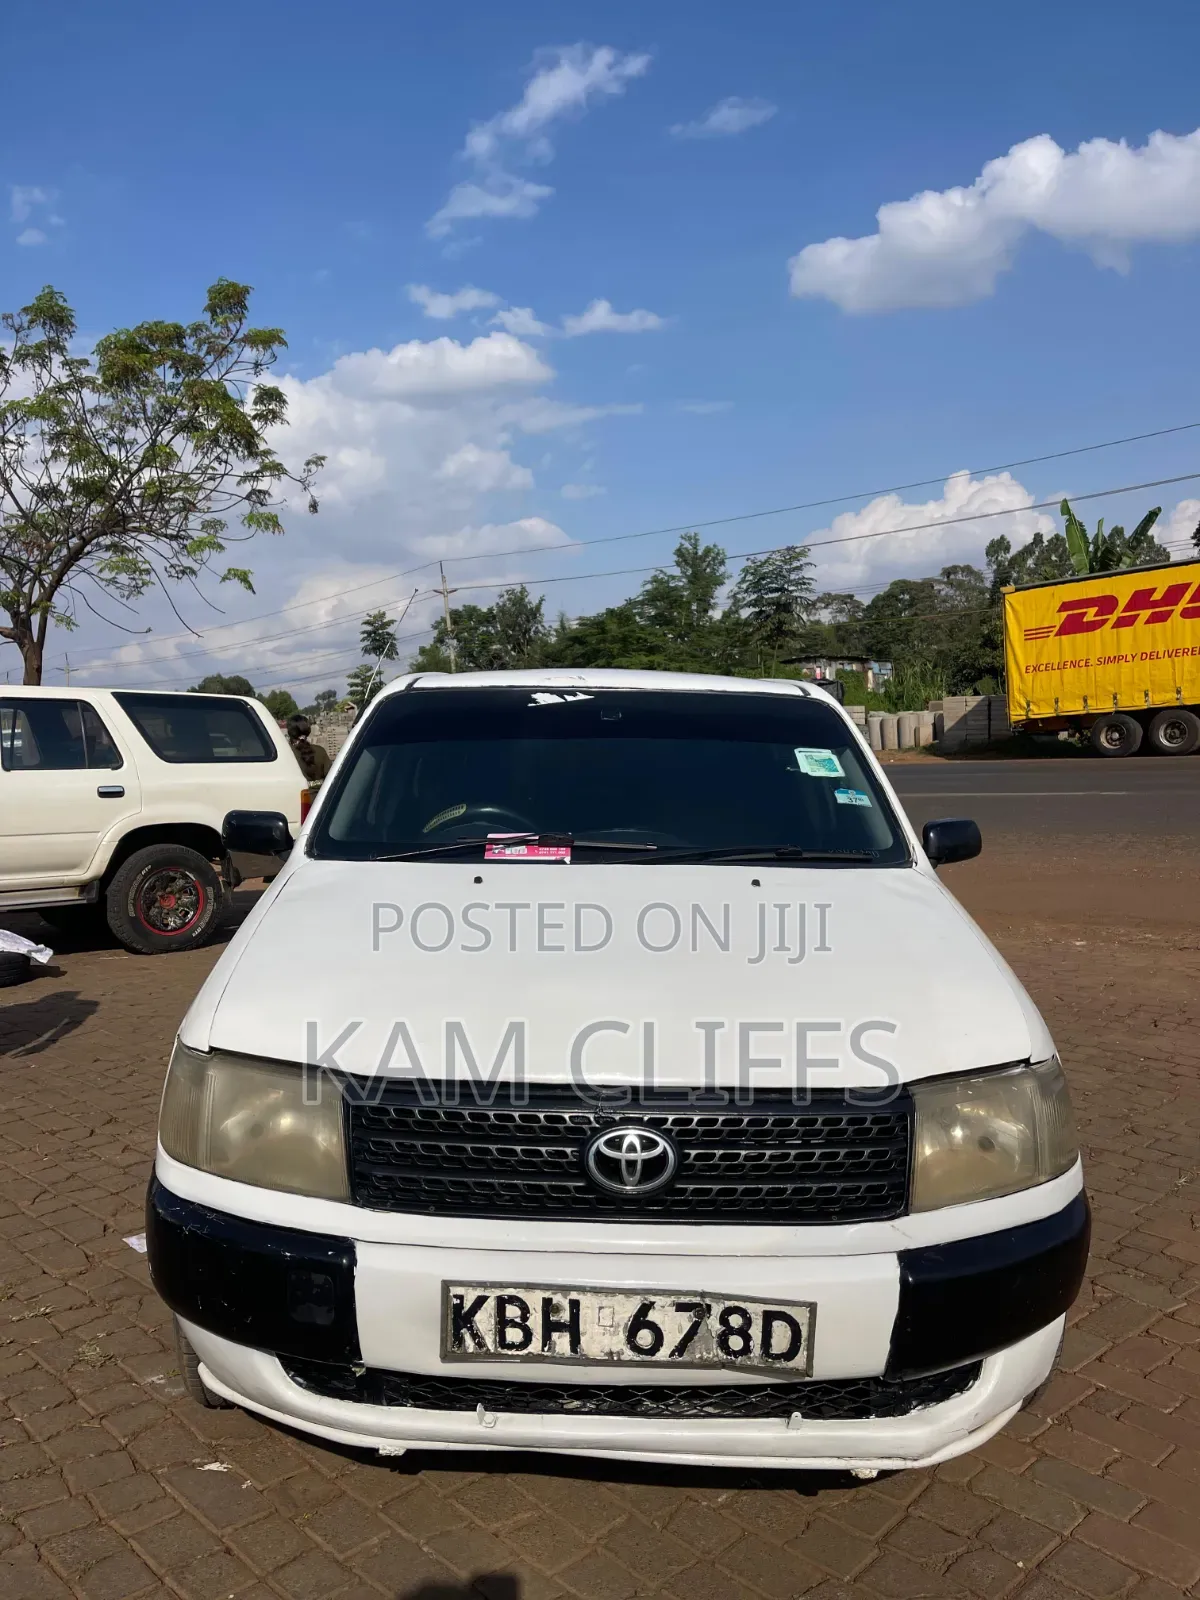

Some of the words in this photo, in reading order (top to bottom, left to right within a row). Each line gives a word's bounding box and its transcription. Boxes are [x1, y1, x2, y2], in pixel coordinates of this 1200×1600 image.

[1024, 658, 1093, 674] EXCELLENCE.
[1096, 653, 1137, 666] SIMPLY
[1140, 646, 1200, 661] DELIVERE
[452, 1293, 581, 1355] KBH
[625, 1300, 802, 1362] 678D
